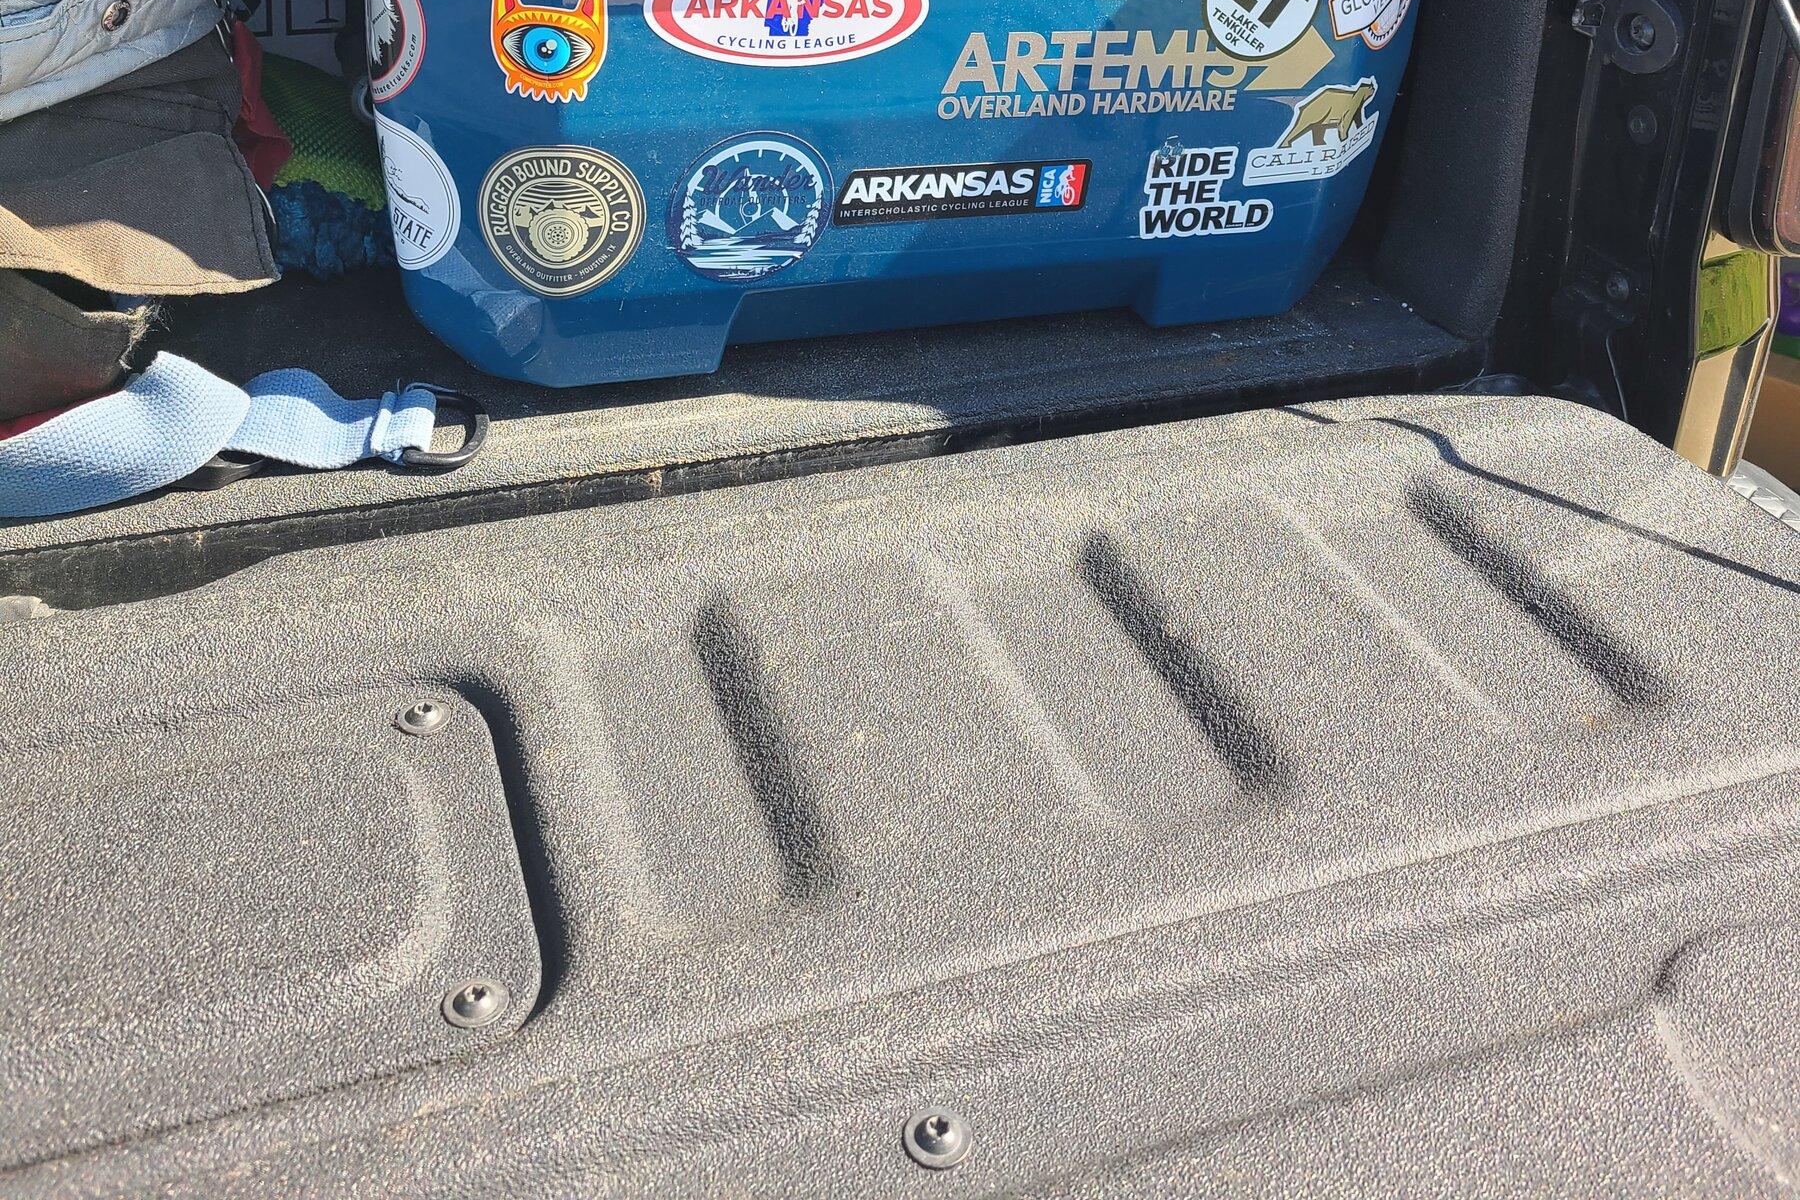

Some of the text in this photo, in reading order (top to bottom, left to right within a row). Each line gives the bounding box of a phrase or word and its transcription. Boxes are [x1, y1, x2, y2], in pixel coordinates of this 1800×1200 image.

[1212, 7, 1266, 53] TENKILLER
[1230, 9, 1259, 34] LAKE
[717, 33, 857, 50] CYCLING LEAGUE
[1225, 32, 1241, 47] OK
[937, 89, 1238, 120] OVERLAND HARDWARE
[1251, 120, 1375, 168] CALI RAISED
[1151, 151, 1235, 179] RIDE
[1311, 163, 1343, 176] LED
[489, 174, 517, 237] RUGGED
[512, 158, 572, 183] BOUND
[575, 161, 629, 207] SUPPLY
[842, 168, 1035, 205] ARKANSAS
[1040, 168, 1056, 204] NICA
[1149, 179, 1219, 207] THE
[839, 198, 1029, 218] INTERSCHOLASTIC CYCLING LEAGUE
[1144, 203, 1270, 234] WORLD
[392, 207, 433, 249] STATE
[505, 244, 535, 275] OVERLAND
[535, 270, 573, 283] OUTFITTER
[607, 243, 618, 253] TX
